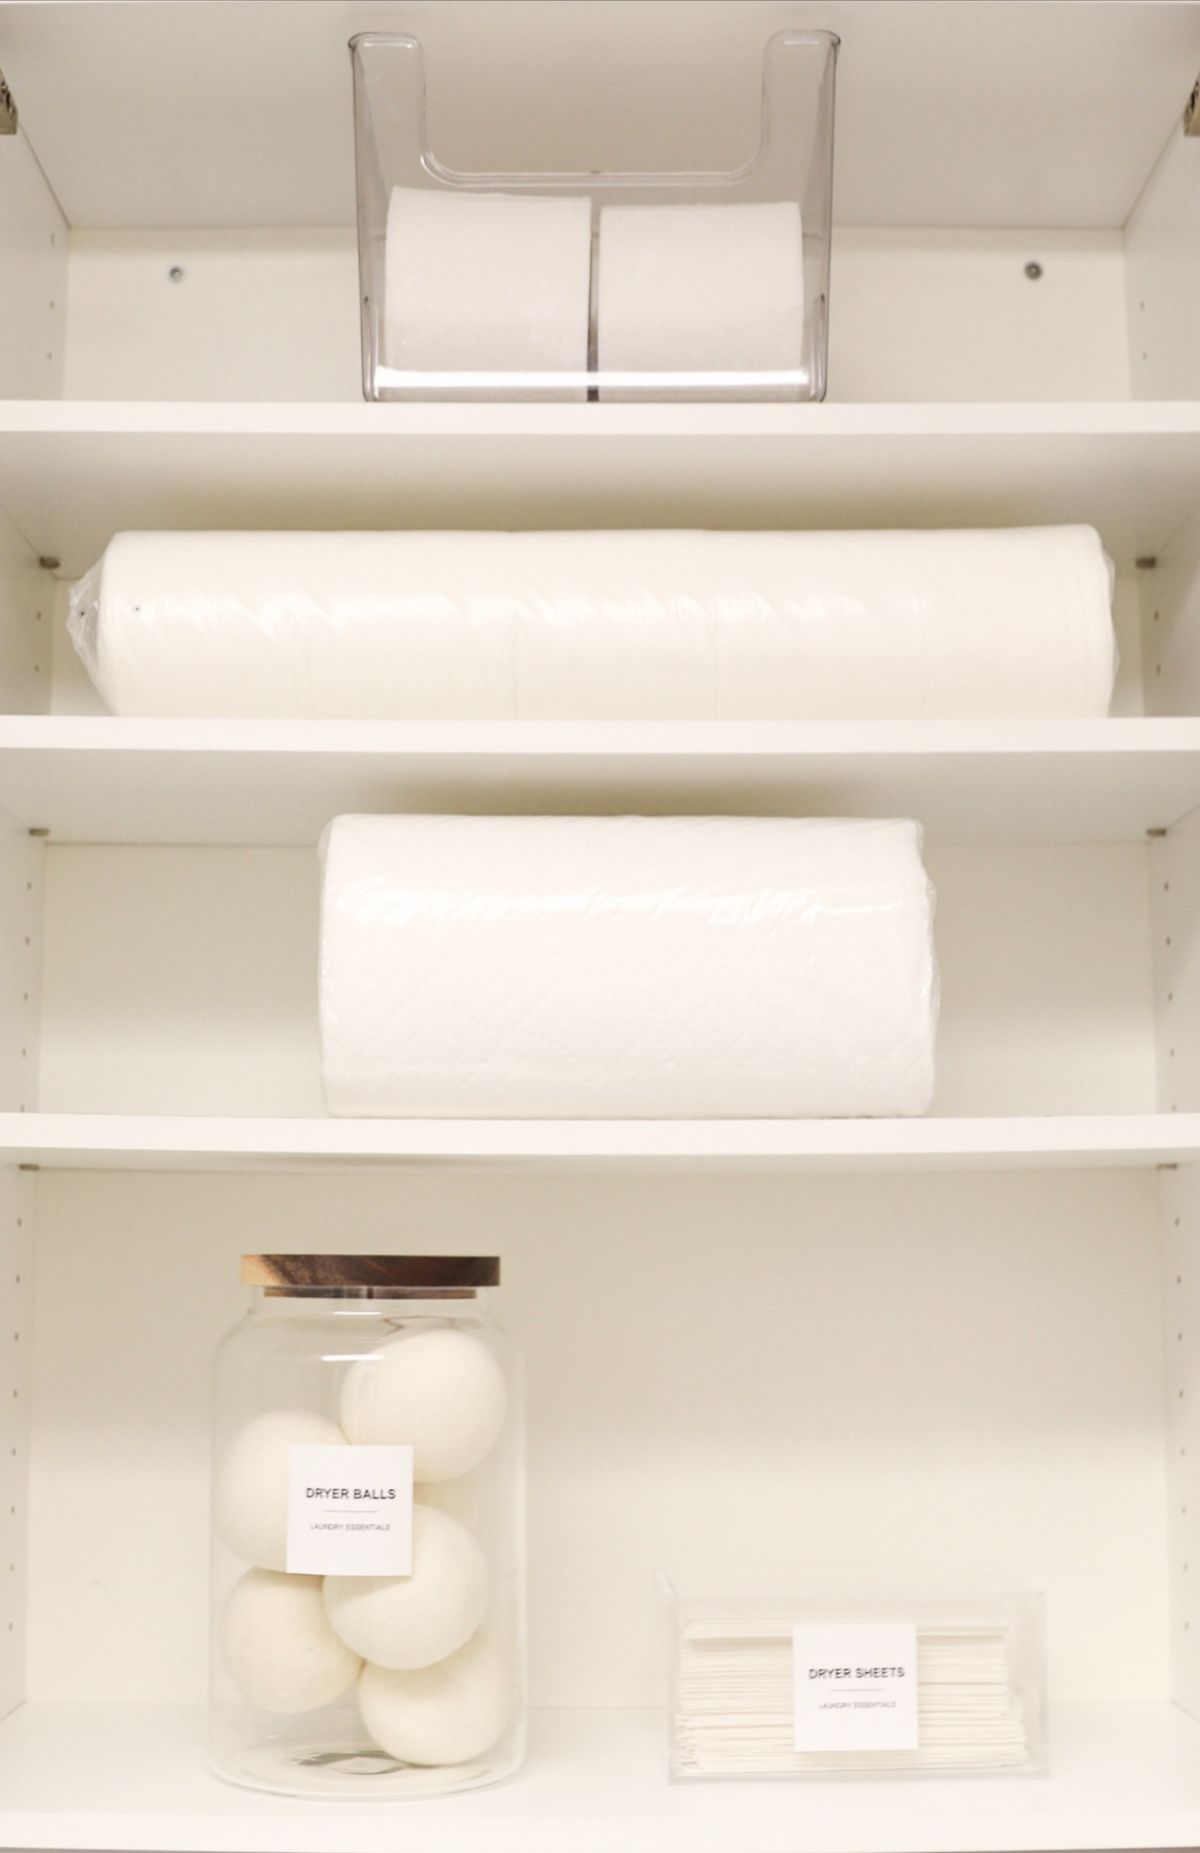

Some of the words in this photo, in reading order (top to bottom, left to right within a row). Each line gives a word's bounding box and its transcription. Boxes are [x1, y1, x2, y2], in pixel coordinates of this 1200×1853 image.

[305, 1487, 350, 1500] DRYER
[353, 1488, 396, 1500] BALLS
[310, 1523, 343, 1531] LAUNDRY
[346, 1523, 391, 1531] ESSENTIALS
[808, 1668, 852, 1680] DRYER
[855, 1667, 905, 1679] SHEETS
